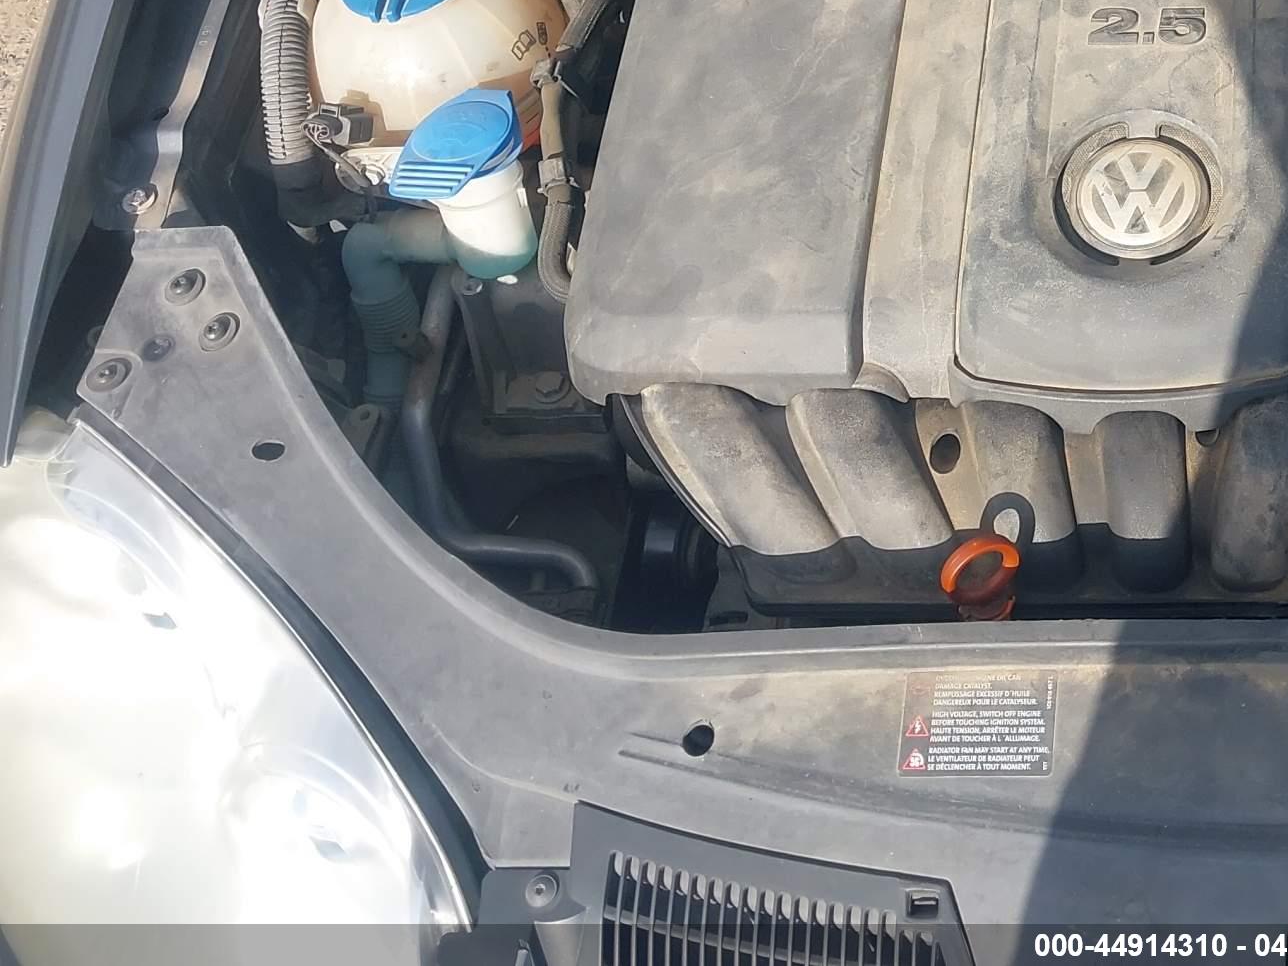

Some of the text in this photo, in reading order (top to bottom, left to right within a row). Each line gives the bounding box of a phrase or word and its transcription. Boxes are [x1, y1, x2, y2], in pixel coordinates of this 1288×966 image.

[1088, 8, 1206, 45] 2.5
[1083, 146, 1192, 240] VW
[932, 710, 949, 718] HIGH
[980, 710, 1003, 718] SWITCH
[1004, 710, 1016, 718] OFF
[1017, 710, 1041, 718] ENGINE
[931, 718, 1046, 726] BEFORE TOUCHING IGNITION SYSTEM.
[930, 726, 952, 734] HAUTE
[1010, 726, 1017, 734] LE
[1018, 726, 1045, 734] MOTEUR
[928, 746, 960, 754] RADIATOR
[961, 746, 974, 754] FAN
[974, 746, 989, 754] MAY
[989, 746, 1009, 754] START
[1009, 746, 1018, 754] AT
[1018, 746, 1032, 754] ANY
[935, 762, 976, 771] DÉCLENCHER
